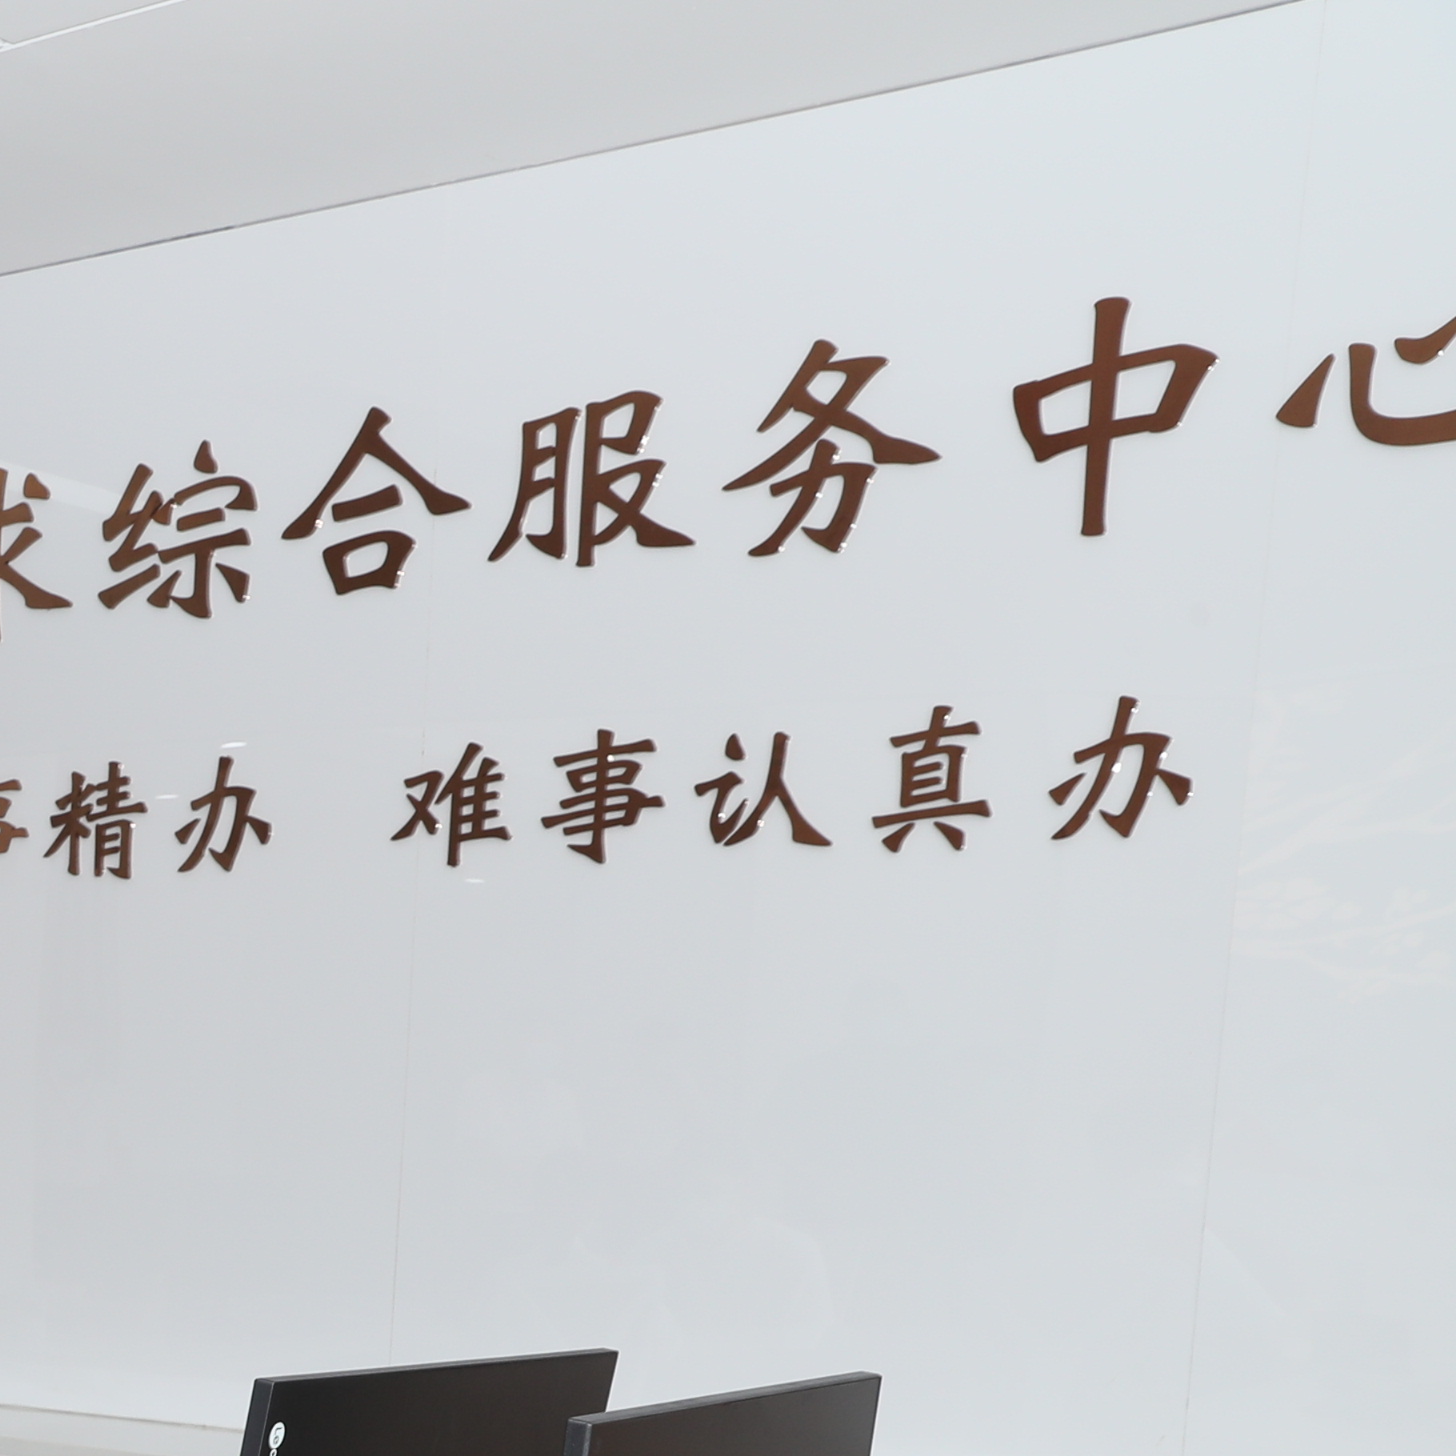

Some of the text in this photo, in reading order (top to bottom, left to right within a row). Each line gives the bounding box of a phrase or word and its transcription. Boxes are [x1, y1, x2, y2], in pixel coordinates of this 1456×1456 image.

[390, 695, 1192, 868] 难事认真办
